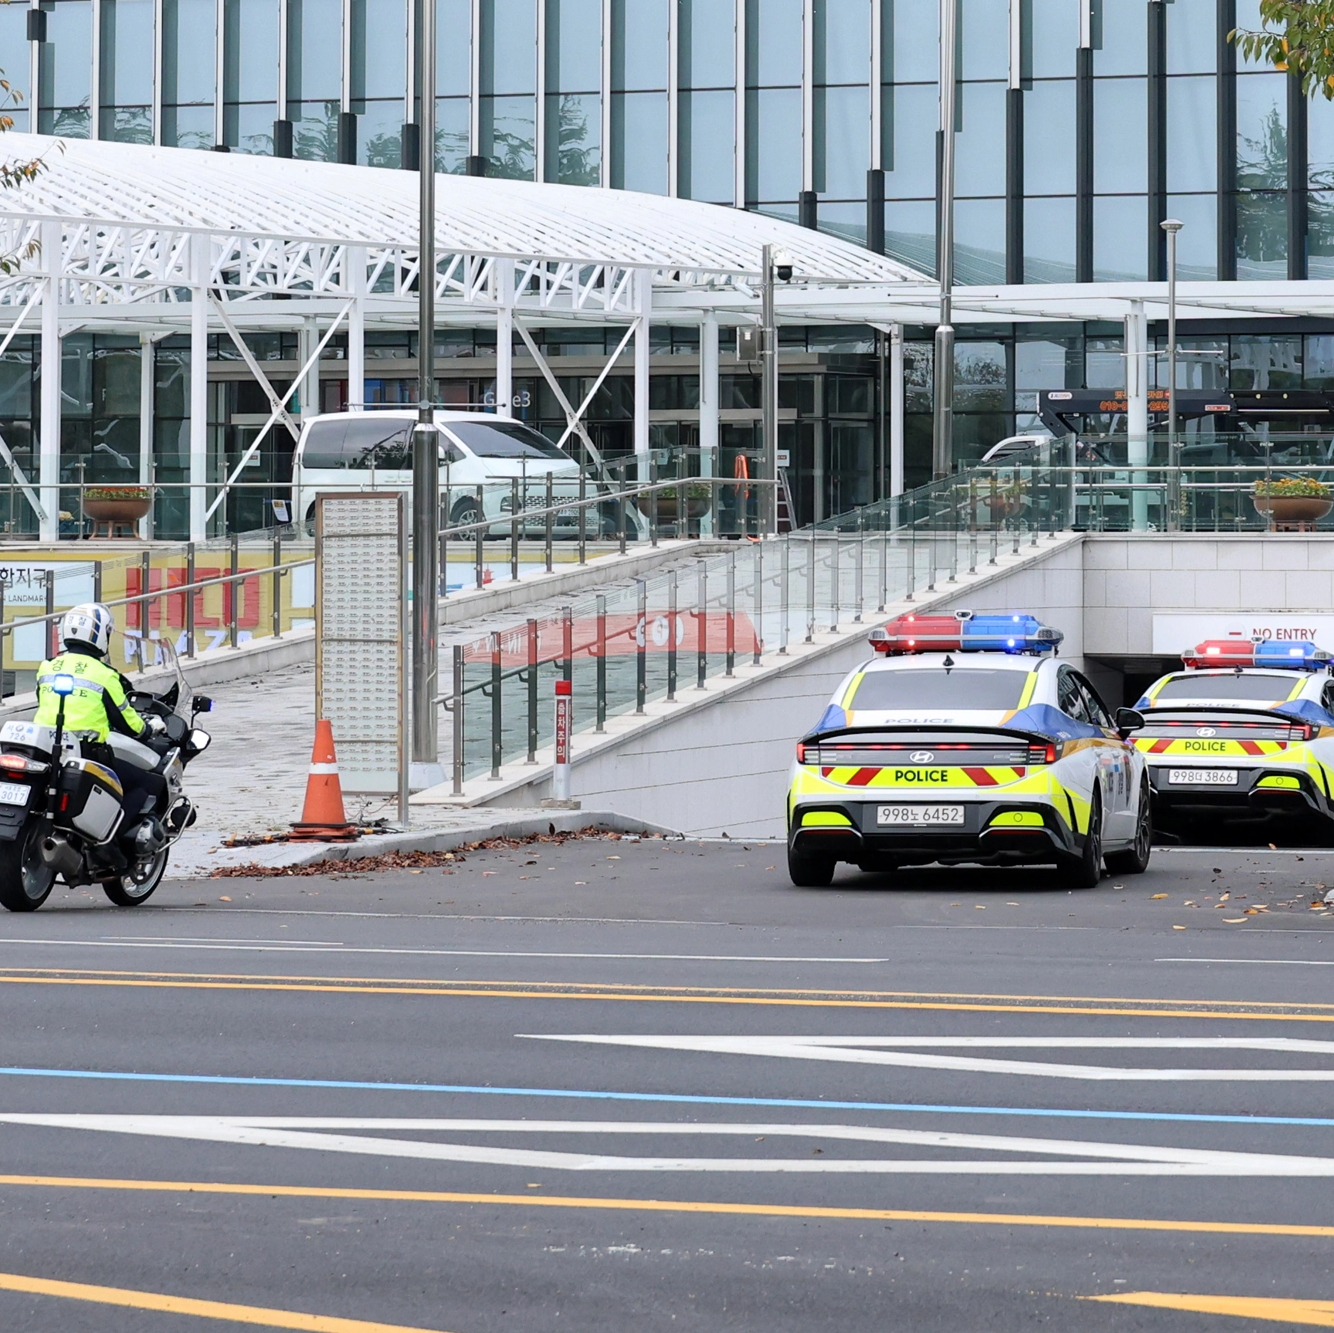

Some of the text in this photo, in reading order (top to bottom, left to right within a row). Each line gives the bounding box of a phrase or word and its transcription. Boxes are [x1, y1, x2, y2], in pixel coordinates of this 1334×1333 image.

[483, 391, 531, 408] Ge3
[1253, 628, 1317, 640] NO ENTRY
[41, 686, 88, 698] POCE
[9, 732, 26, 742] 726
[49, 730, 69, 742] POCE
[1184, 741, 1226, 751] POLICE
[895, 770, 948, 782] POLICE
[1204, 771, 1233, 782] 3866
[1, 791, 25, 802] 3017
[882, 808, 959, 822] 998노 6452
